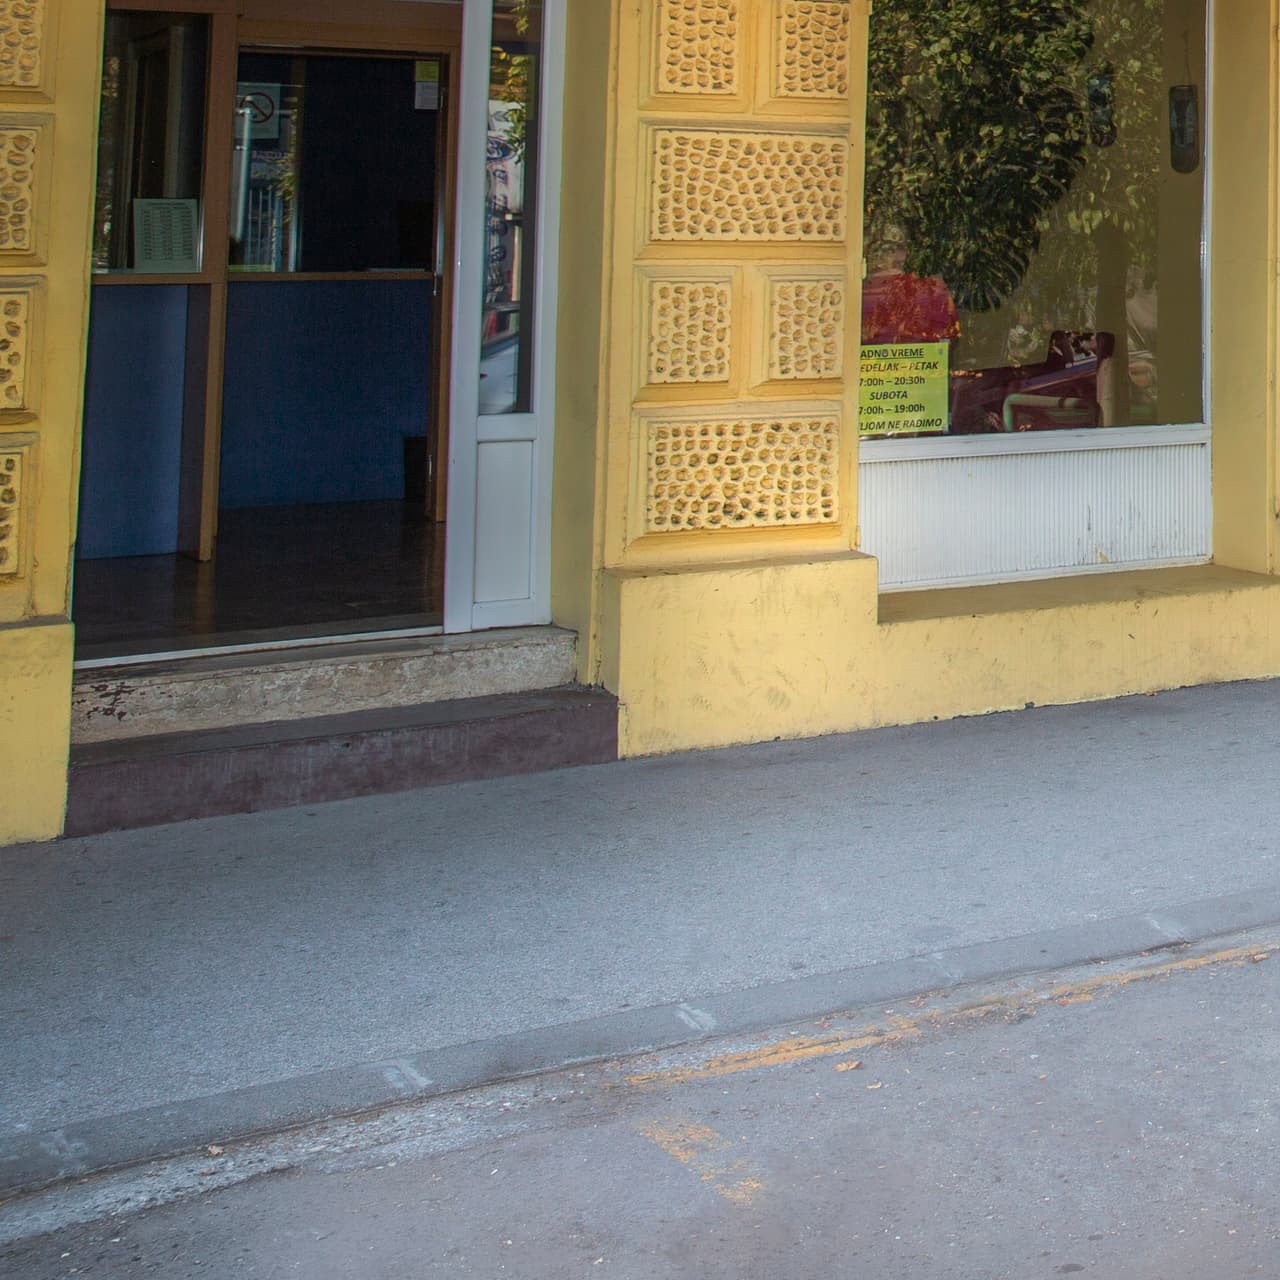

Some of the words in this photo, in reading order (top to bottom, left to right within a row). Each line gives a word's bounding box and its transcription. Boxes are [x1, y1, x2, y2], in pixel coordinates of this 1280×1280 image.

[860, 348, 888, 358] ADNO
[891, 348, 925, 357] VREME
[908, 361, 939, 371] PETAK
[894, 376, 925, 385] 20:30h
[869, 391, 908, 400] SUBOTA
[894, 403, 925, 413] 19:00h
[887, 420, 900, 429] NE
[902, 418, 943, 428] RADIMO
